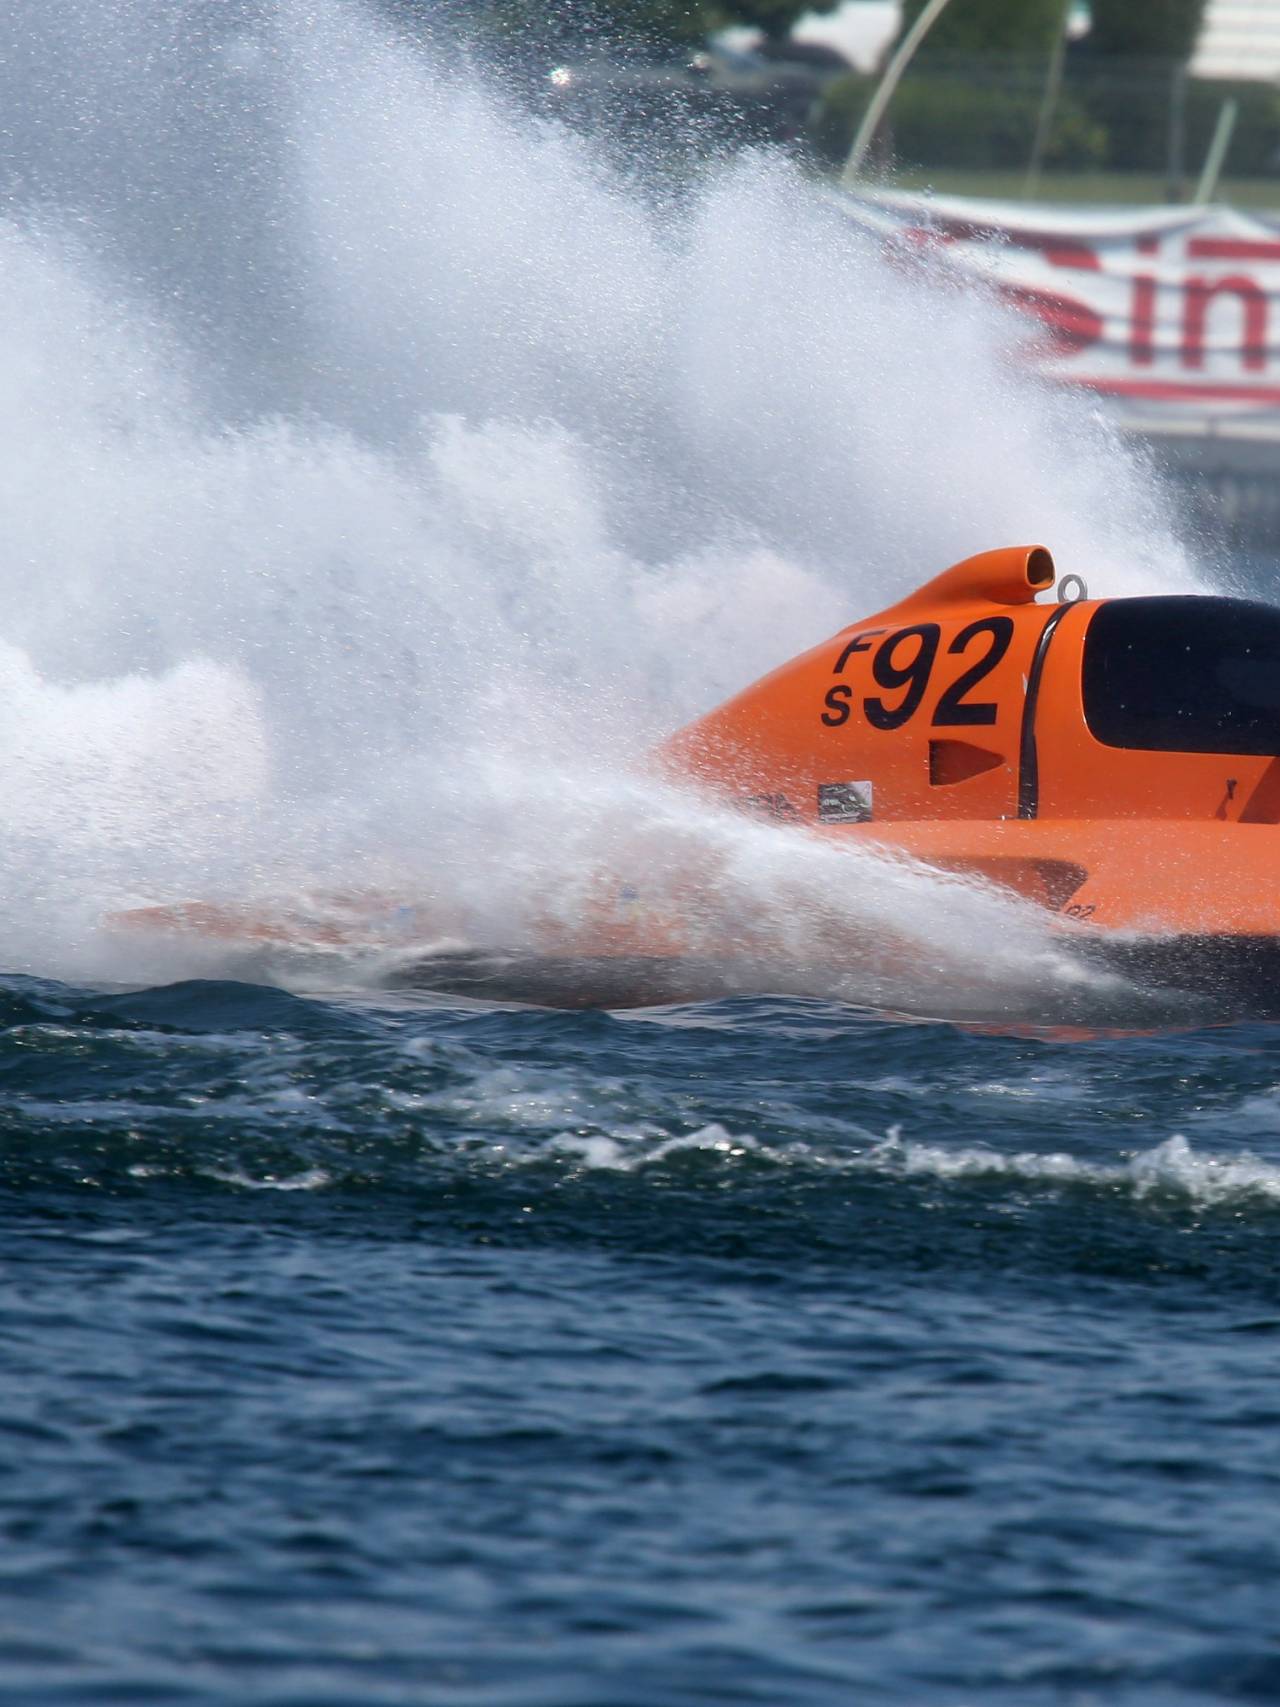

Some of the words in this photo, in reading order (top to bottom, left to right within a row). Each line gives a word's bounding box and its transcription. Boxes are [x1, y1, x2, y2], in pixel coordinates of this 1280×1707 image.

[832, 630, 888, 674] F
[863, 616, 1014, 730] 92
[821, 685, 852, 726] S
